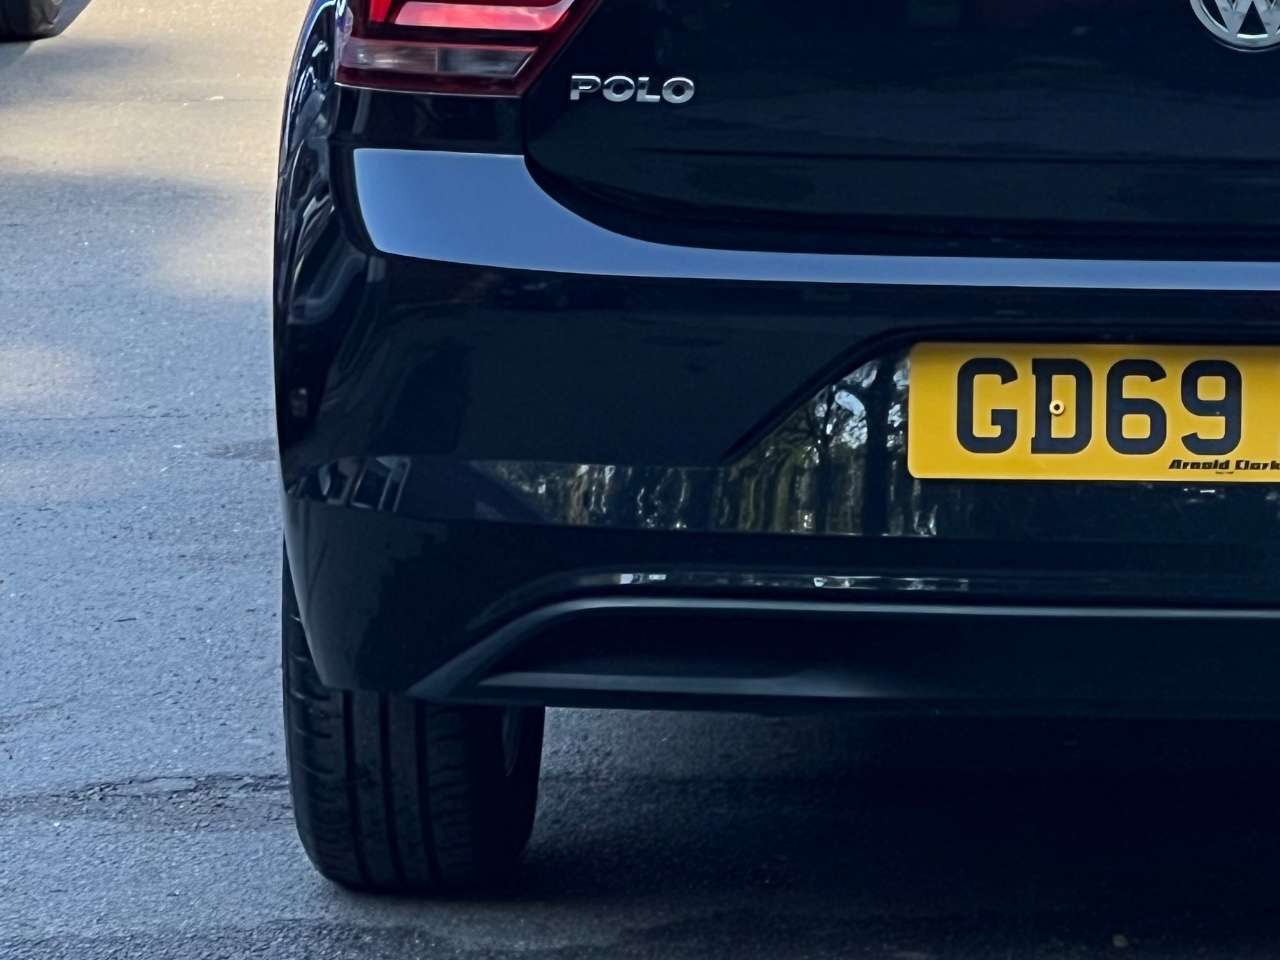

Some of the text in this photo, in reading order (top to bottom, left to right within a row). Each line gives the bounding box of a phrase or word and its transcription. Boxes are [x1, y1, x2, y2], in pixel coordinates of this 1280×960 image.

[569, 74, 695, 103] POLO
[956, 357, 1242, 455] GD69
[1168, 459, 1280, 470] Arnold Clark
